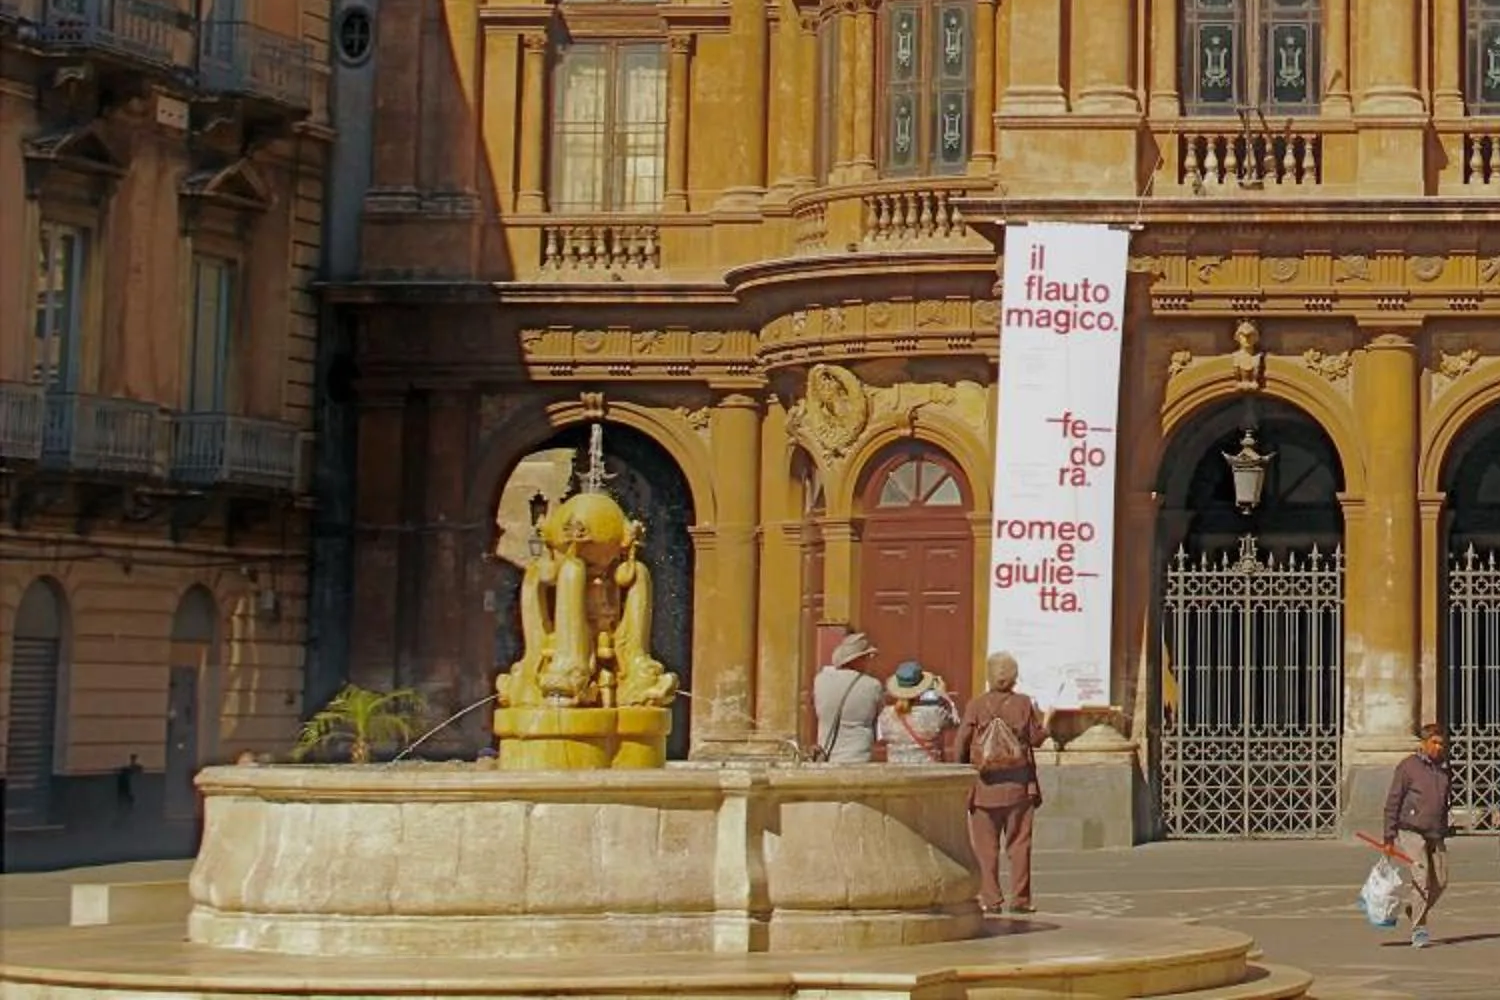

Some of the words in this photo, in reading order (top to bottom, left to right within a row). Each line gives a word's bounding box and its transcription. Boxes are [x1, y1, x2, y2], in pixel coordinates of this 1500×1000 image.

[1030, 243, 1045, 271] il
[1024, 275, 1110, 303] flauto
[1005, 304, 1118, 335] magico.
[1070, 440, 1105, 467] do
[1058, 467, 1092, 488] ra.
[996, 519, 1095, 541] romeo
[1057, 542, 1075, 562] e
[1038, 586, 1083, 612] tta.
